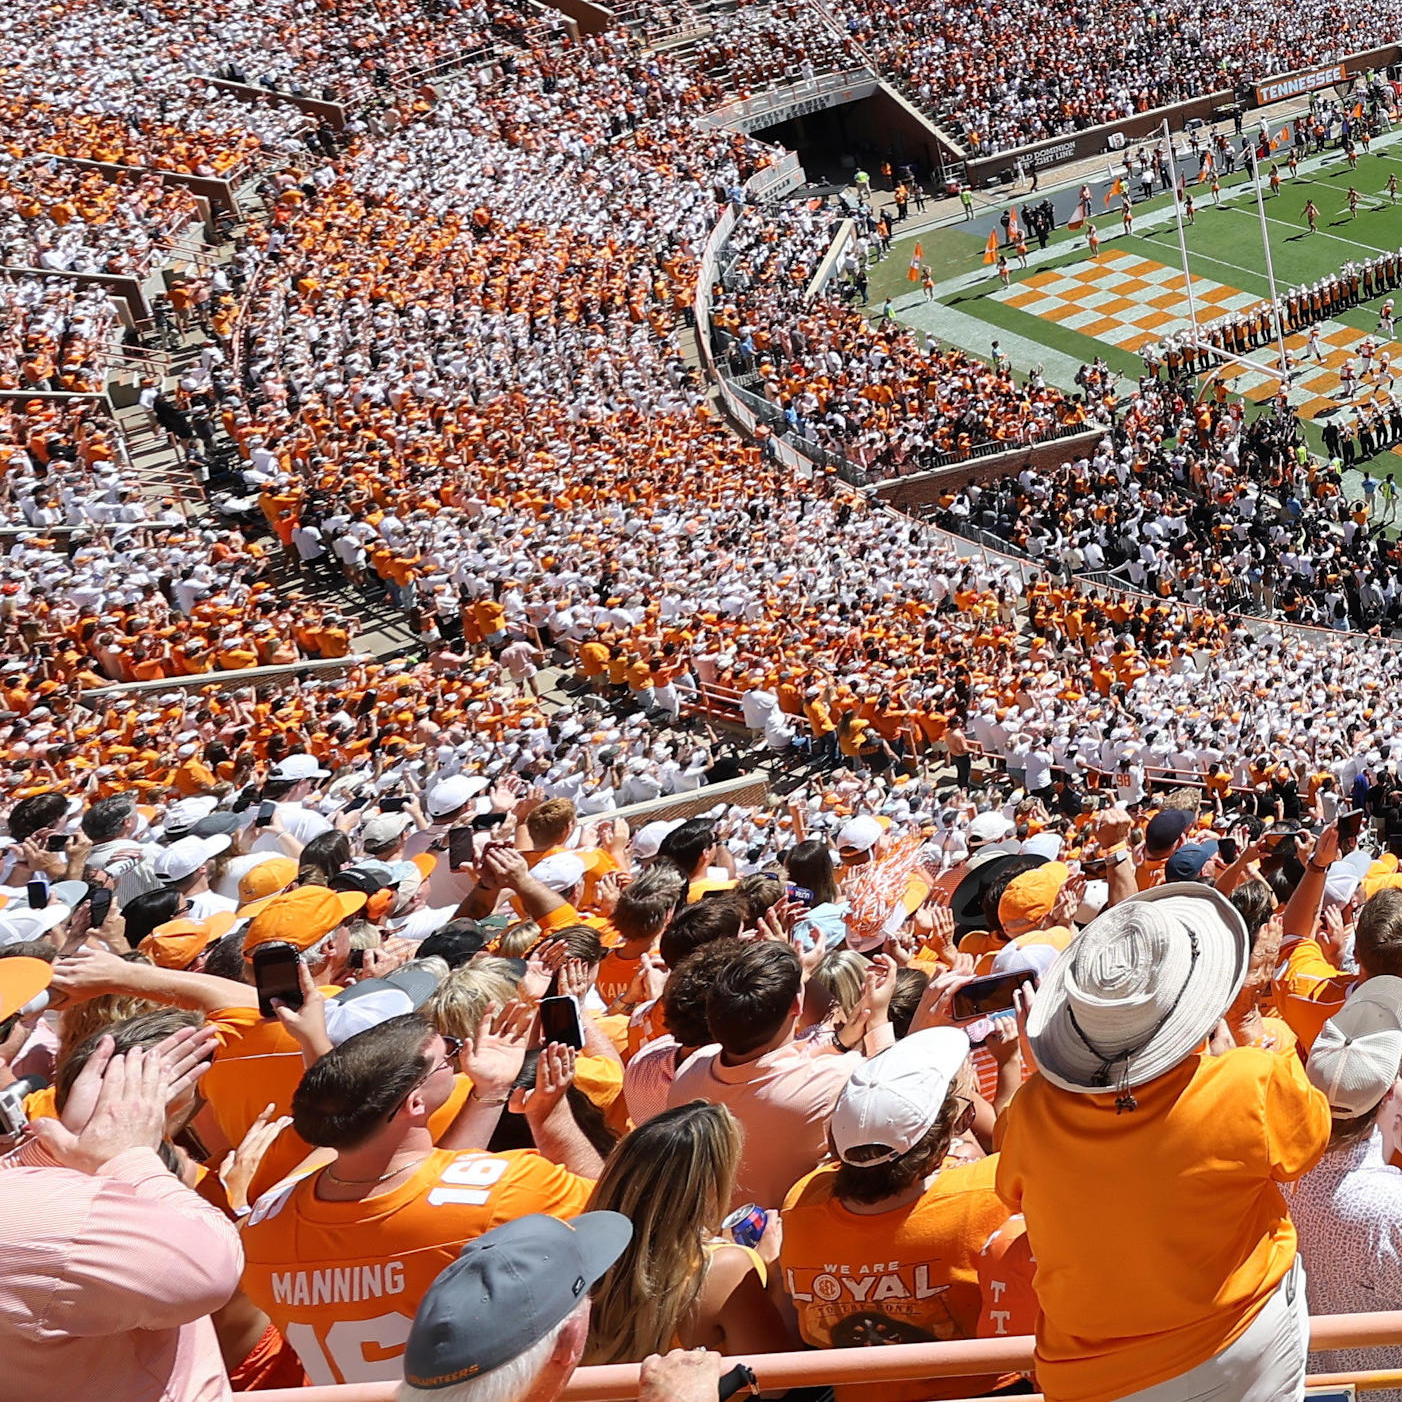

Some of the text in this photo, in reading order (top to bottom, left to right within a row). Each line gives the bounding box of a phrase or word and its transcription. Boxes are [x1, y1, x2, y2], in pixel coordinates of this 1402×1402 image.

[1259, 67, 1342, 101] TENNESSEE
[1034, 141, 1076, 158] DOMINION
[1054, 149, 1074, 161] LINE
[426, 1155, 509, 1206] 16
[824, 1261, 900, 1274] WE ARE
[271, 1261, 405, 1306] MANNING
[786, 1263, 951, 1302] LOYAL
[989, 1280, 1006, 1302] T
[989, 1310, 1010, 1334] T
